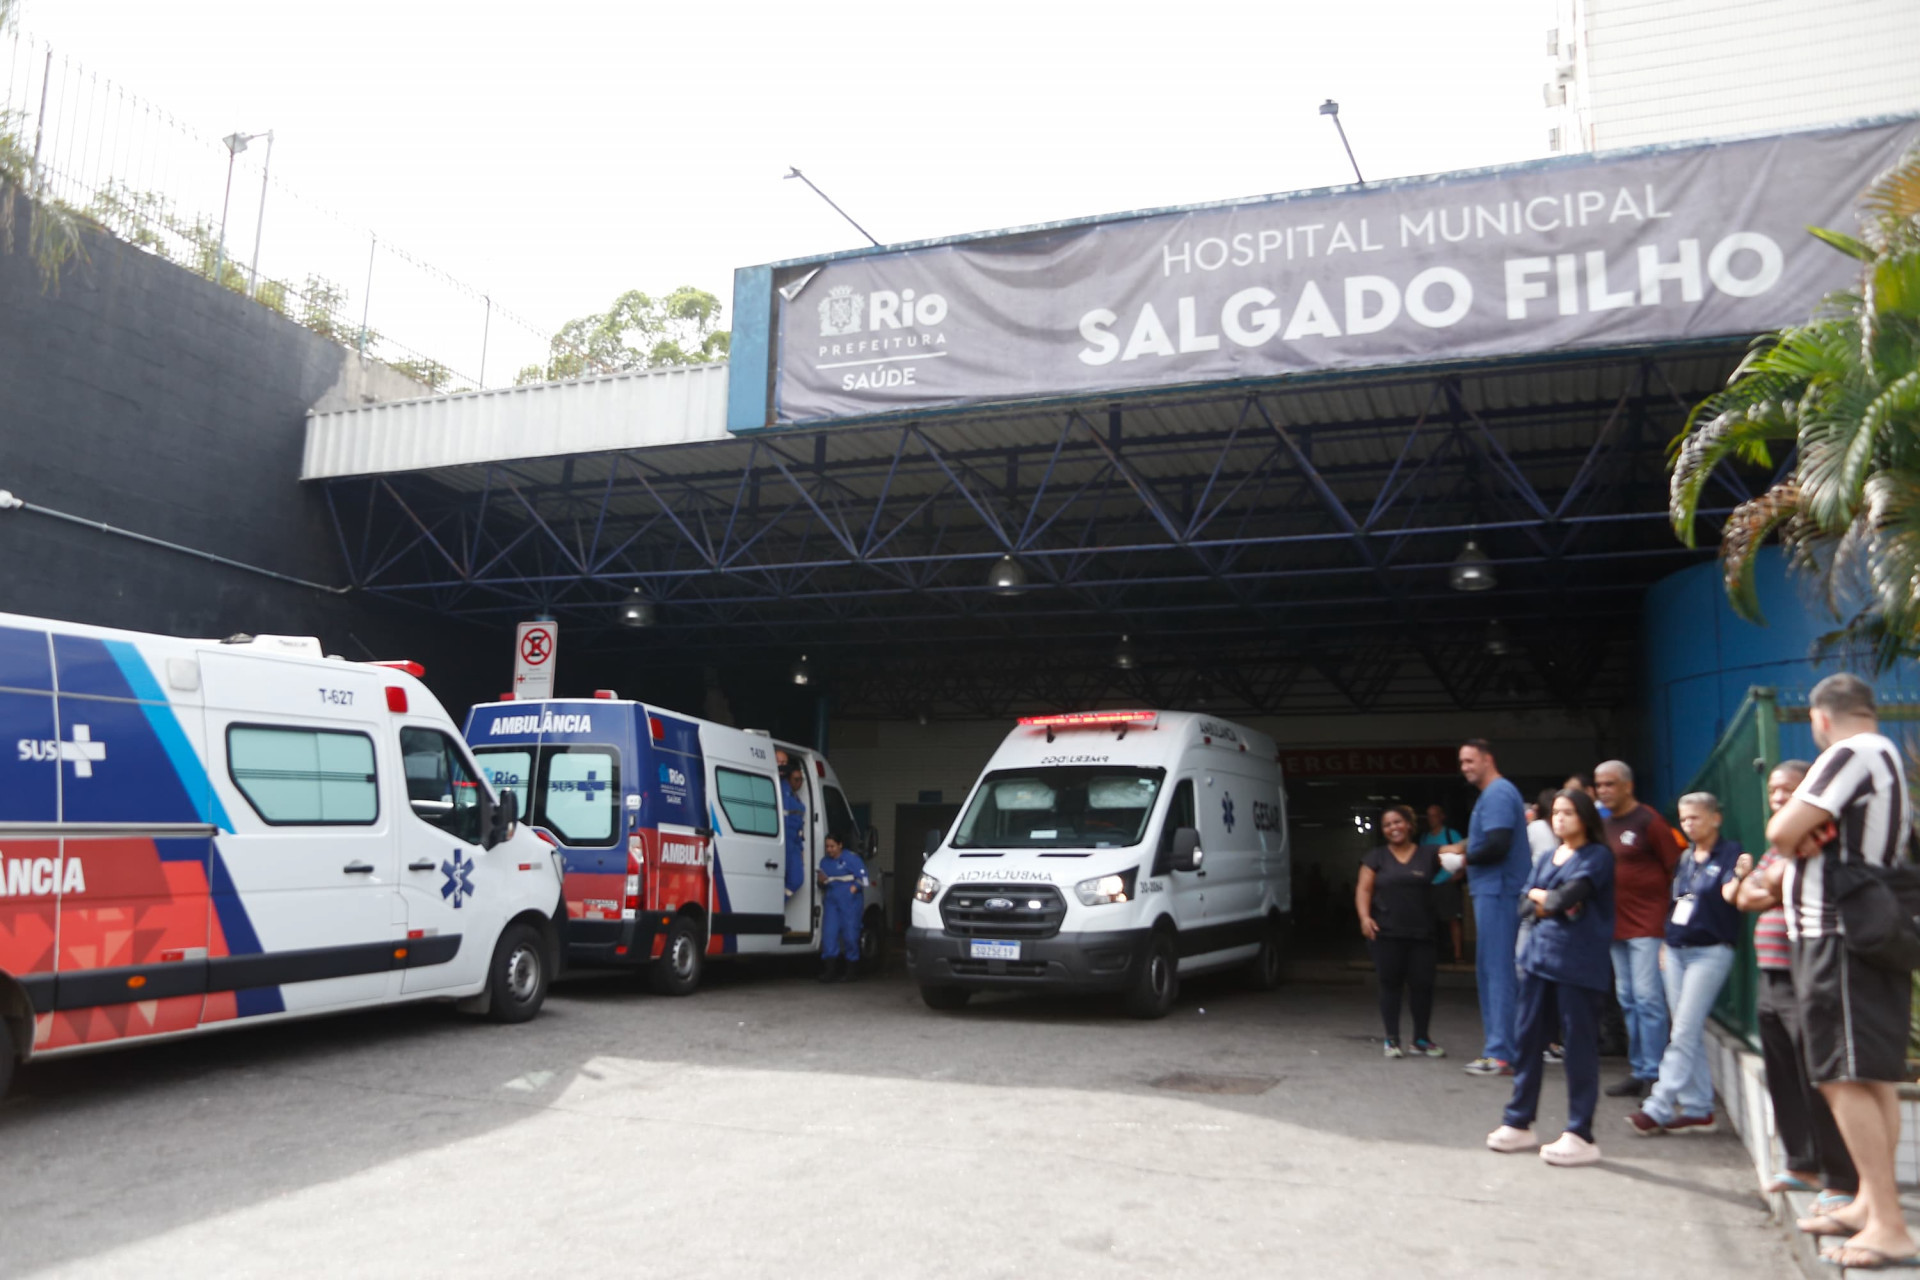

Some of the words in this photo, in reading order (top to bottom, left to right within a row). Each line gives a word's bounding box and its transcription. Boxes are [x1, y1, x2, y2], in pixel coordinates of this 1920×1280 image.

[1162, 218, 1384, 278] HOSPITAL
[1400, 183, 1672, 248] MUNICIPAL
[869, 288, 948, 331] Rio
[1077, 266, 1474, 367] SALGADO
[1503, 231, 1785, 320] FILHO
[819, 333, 946, 357] PREFEITURA
[841, 364, 916, 391] SAÚDE
[318, 688, 354, 705] T-627
[489, 711, 591, 735] AMBULÂNCIA
[17, 738, 59, 760] SUS
[494, 771, 519, 785] Rio
[668, 767, 686, 787] Rio
